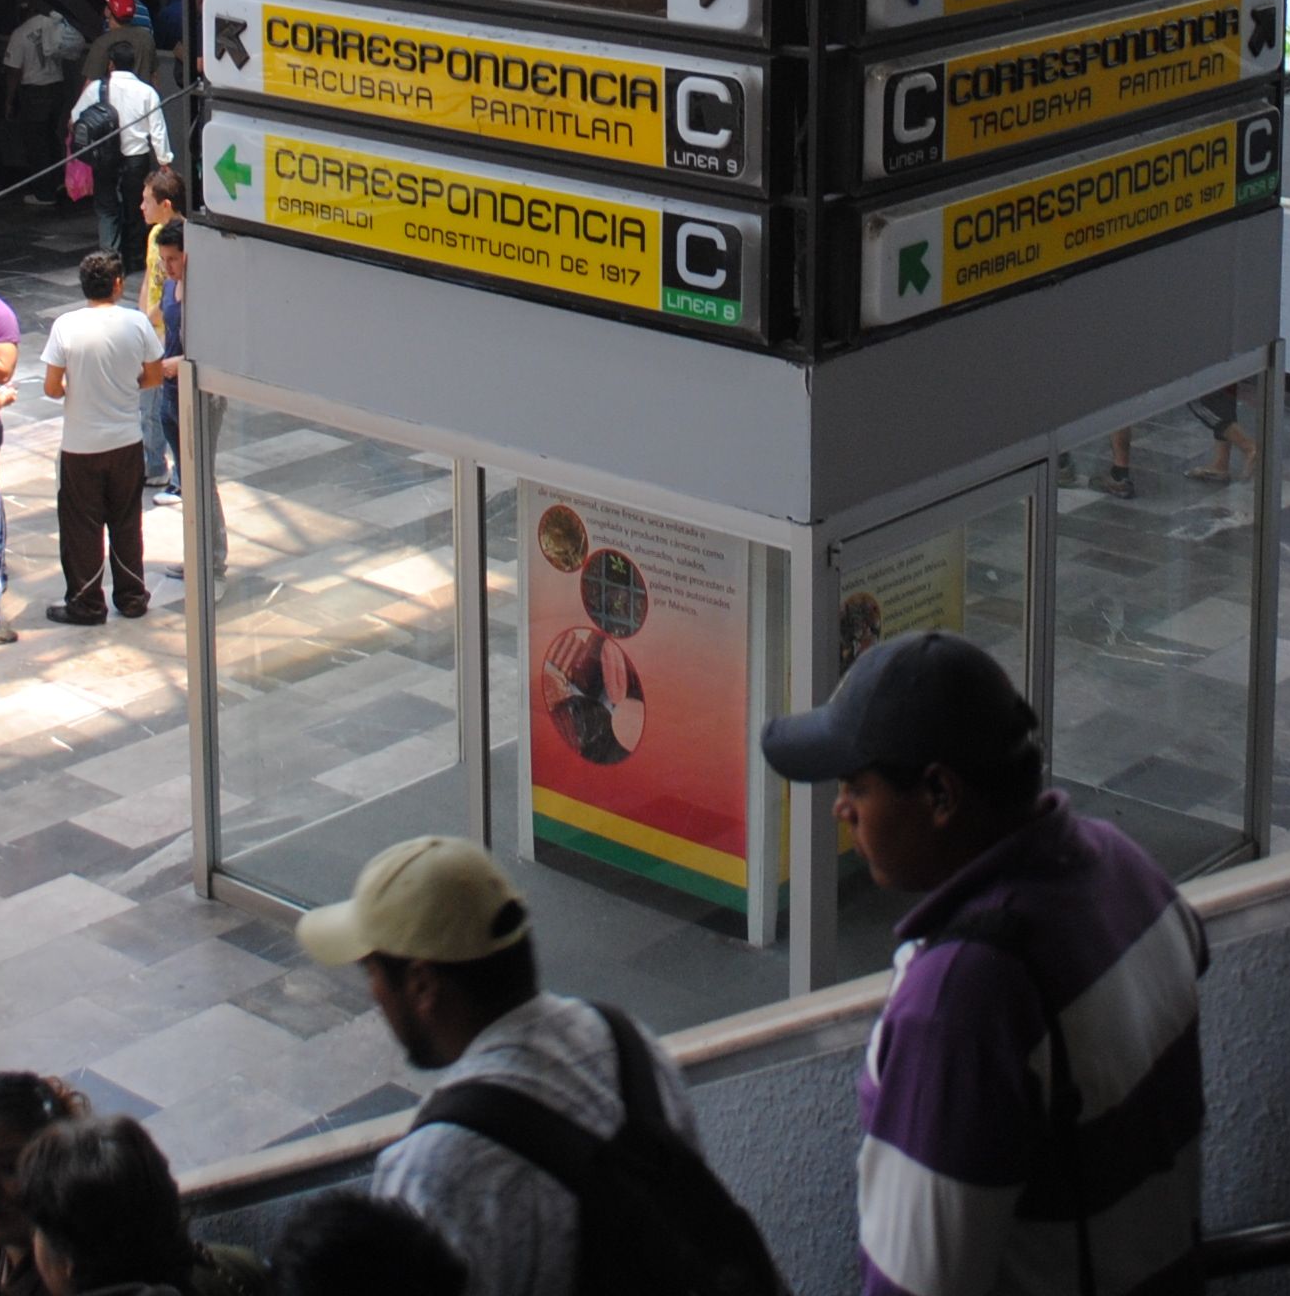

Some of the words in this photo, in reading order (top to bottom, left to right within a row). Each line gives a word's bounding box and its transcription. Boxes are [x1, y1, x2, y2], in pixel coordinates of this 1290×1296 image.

[266, 17, 659, 112] CORRESPONDENCIA
[948, 6, 1239, 107] CORRESPONDENCIA
[969, 86, 1091, 140] TACUBAYA
[1119, 52, 1224, 101] PANTITLAN
[287, 64, 433, 111] TACUBAYA
[471, 97, 633, 146] PANTITLAN
[676, 76, 732, 150] C
[892, 71, 937, 144] C
[674, 150, 720, 172] LINEA
[727, 158, 738, 175] 9
[889, 150, 924, 170] LINEA
[1243, 118, 1273, 175] C
[275, 149, 646, 254] CORRESPONDENCIA
[953, 136, 1228, 251] CORRESPONDENCIA
[956, 243, 1040, 286] GARIBALDI
[1064, 204, 1169, 250] CONSTITUCION
[1174, 195, 1193, 213] DE
[1199, 182, 1225, 204] 1917
[278, 196, 374, 231] GARIBALDI
[404, 221, 550, 268] CONSTITUCION
[561, 254, 589, 276] DE
[600, 263, 640, 287] 1917
[677, 222, 727, 290] C
[667, 293, 717, 317] LINEA
[724, 305, 736, 322] 8
